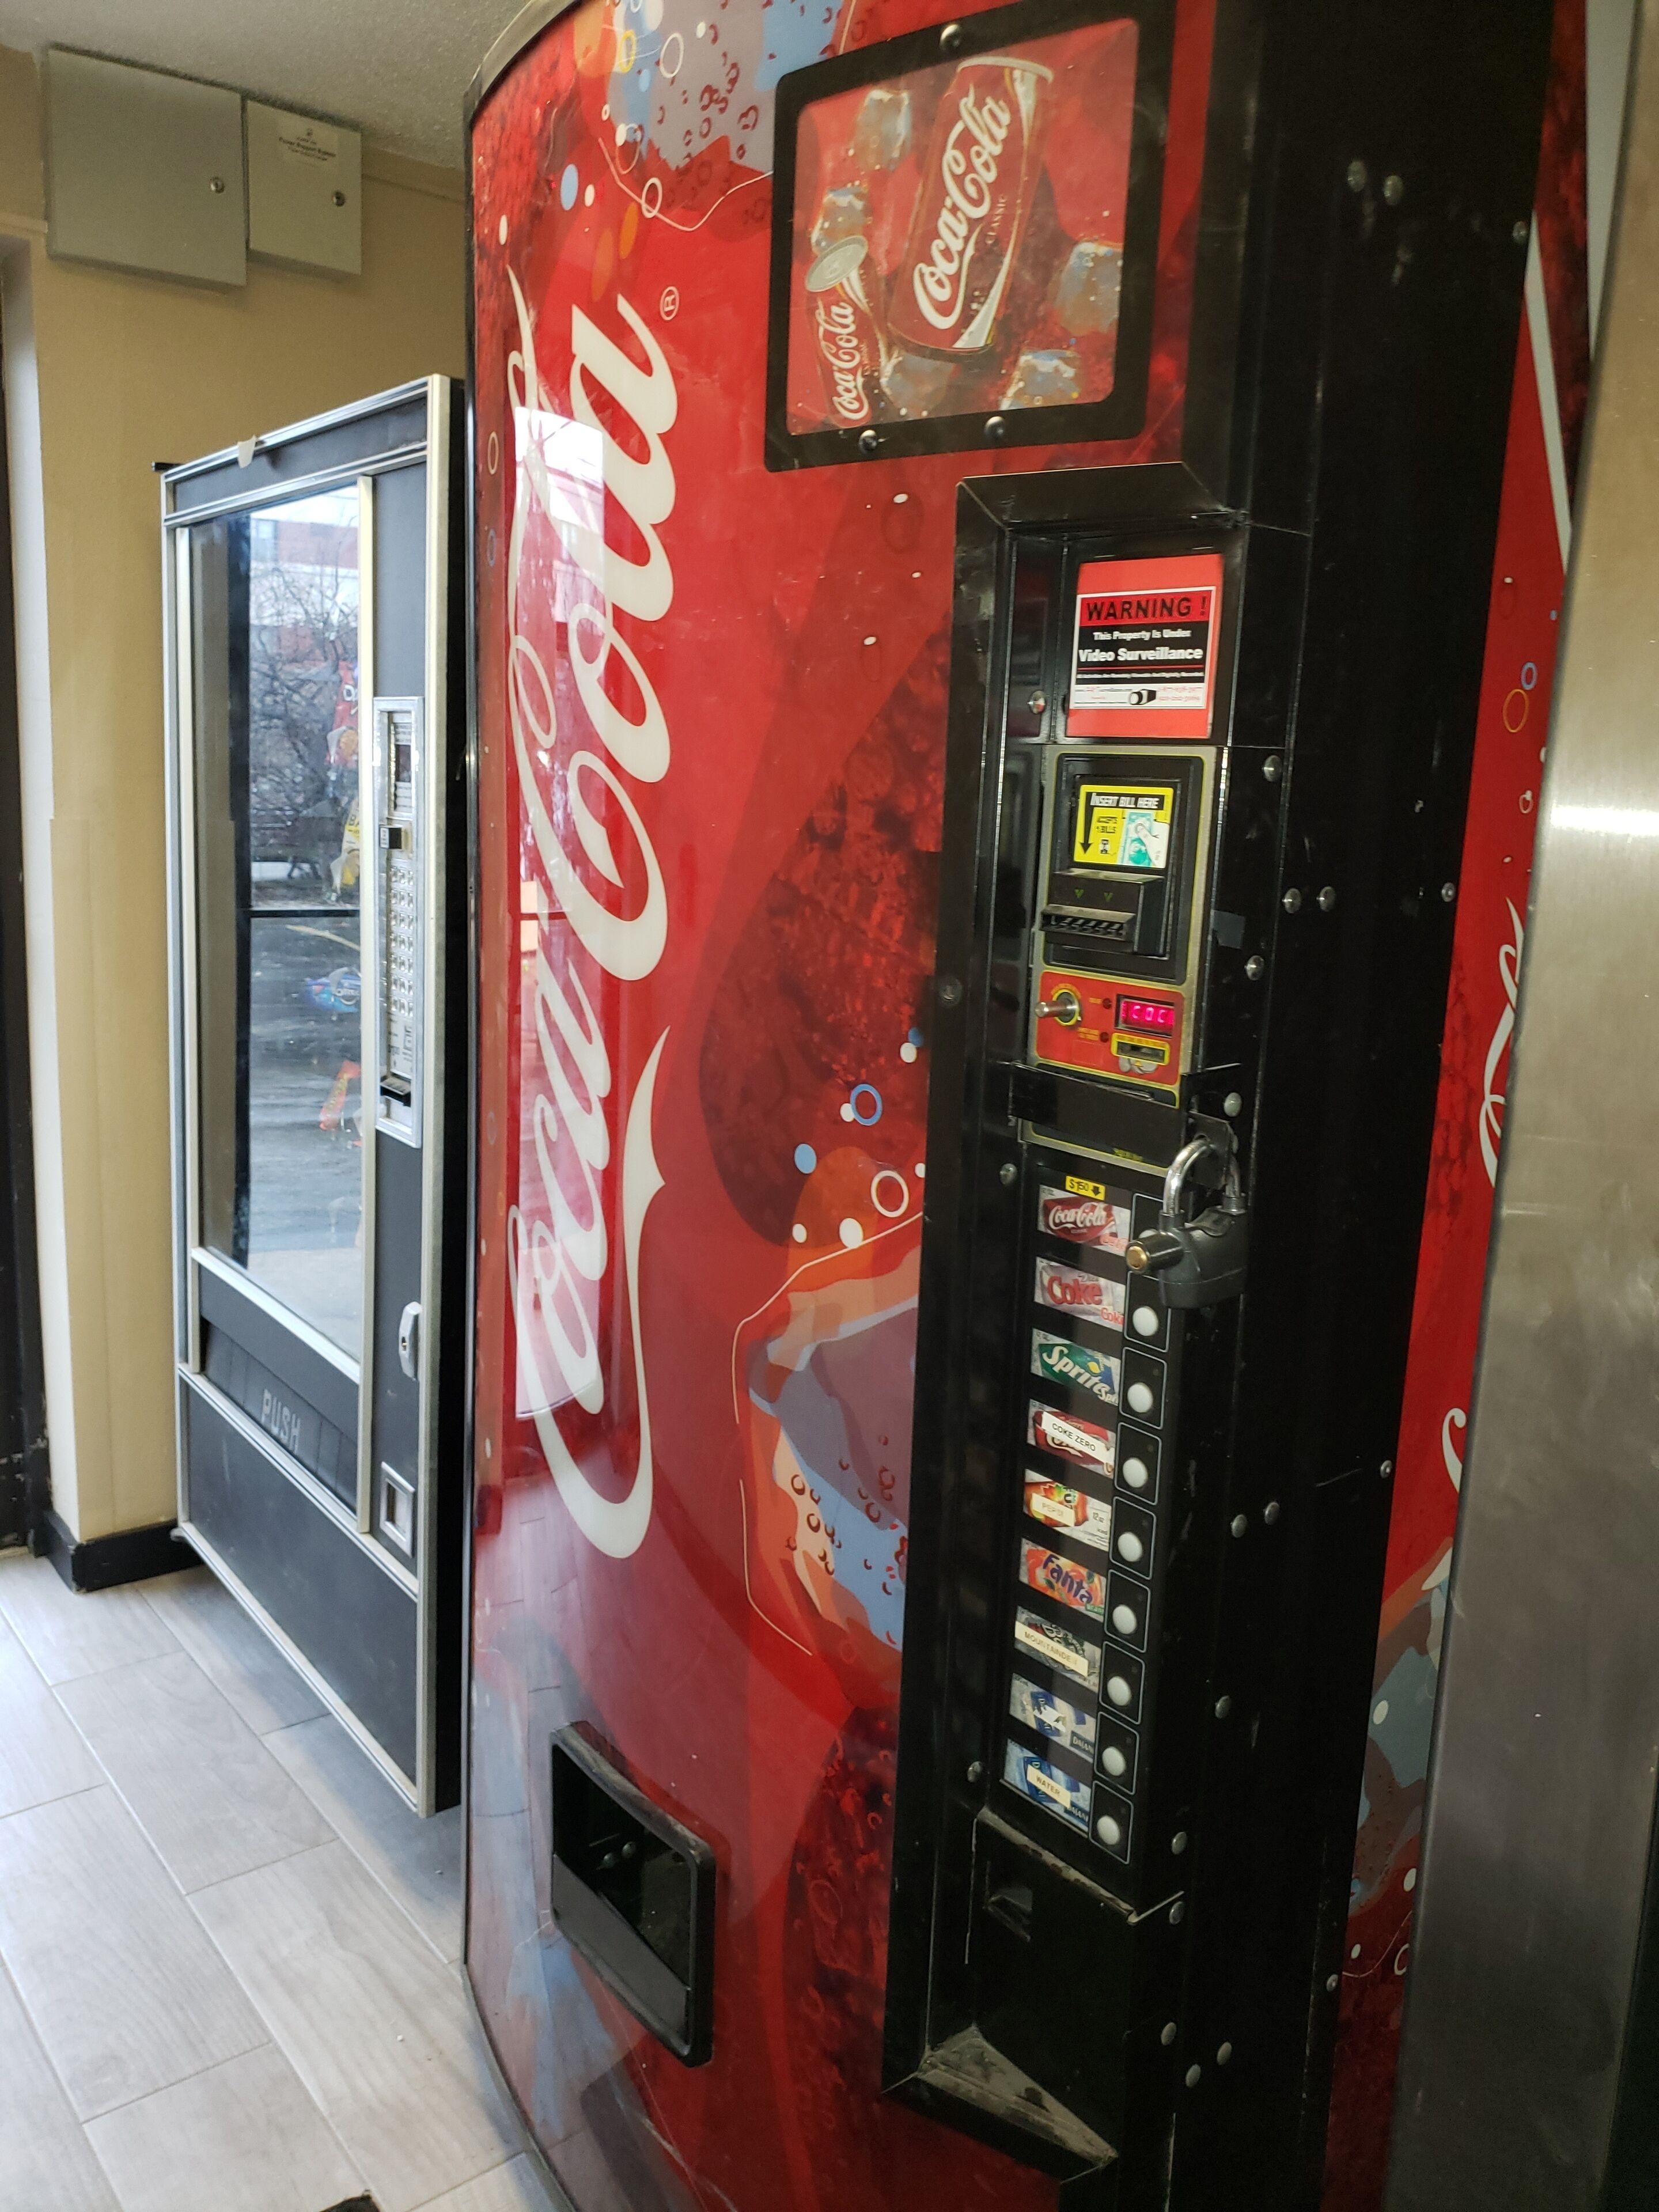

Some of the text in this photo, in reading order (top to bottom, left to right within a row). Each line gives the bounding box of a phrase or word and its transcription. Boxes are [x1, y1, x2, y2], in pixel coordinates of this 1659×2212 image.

[1086, 597, 1192, 622] WARNING
[1093, 632, 1112, 641] This
[1112, 630, 1151, 641] Property
[1162, 628, 1192, 638] Under
[1078, 646, 1204, 662] Video Surveillance
[1090, 792, 1160, 809] INSERT BILL HERE
[1047, 1275, 1103, 1305] Coke
[1042, 1346, 1111, 1395] Sprite
[262, 1388, 301, 1455] PUSH
[1052, 1423, 1096, 1452] COKE ZERO
[1043, 1554, 1093, 1604] Fanta
[1036, 1774, 1061, 1797] WATER
